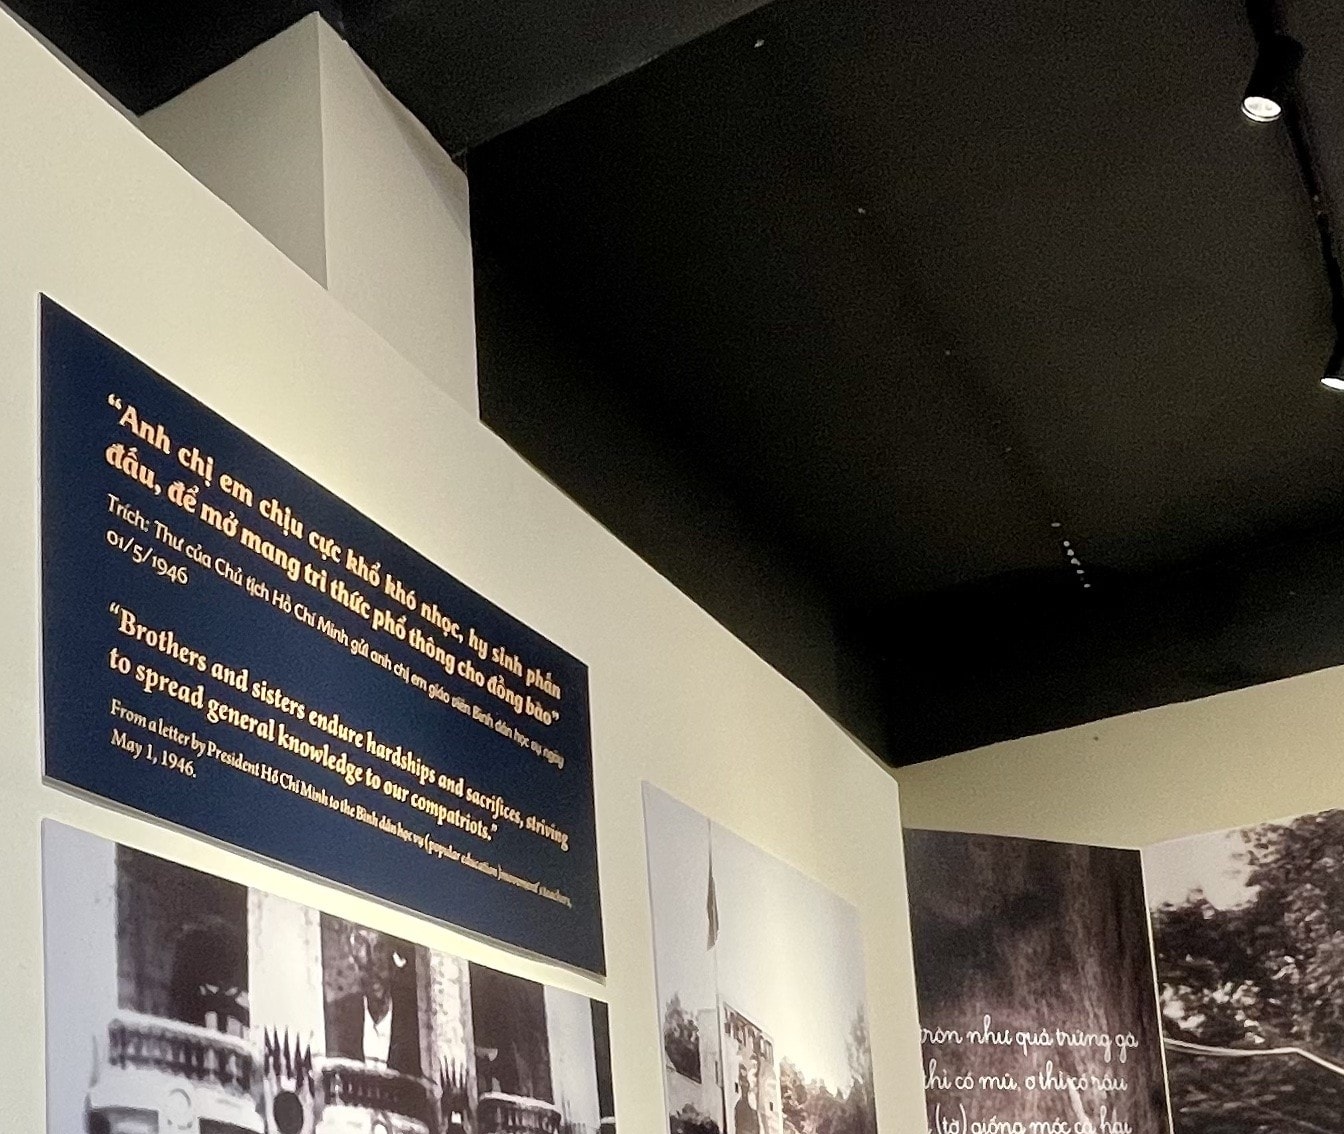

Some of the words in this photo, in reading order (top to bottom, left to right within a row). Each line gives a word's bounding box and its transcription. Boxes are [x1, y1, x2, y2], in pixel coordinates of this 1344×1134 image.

[106, 530, 189, 585] 01/5/1946
[154, 520, 185, 551] Thư
[186, 544, 212, 568] của
[215, 558, 244, 587] Chủ
[245, 575, 270, 601] tịch
[272, 589, 292, 613] Hồ
[294, 603, 316, 627] Chí
[317, 616, 348, 646] Minh
[370, 650, 392, 671] anh
[411, 673, 427, 692] em
[167, 480, 199, 513] để
[200, 503, 239, 537] mở
[240, 527, 301, 581] mang
[330, 580, 371, 619] thức
[372, 608, 407, 640] phổ
[409, 629, 455, 675] thông
[457, 660, 485, 687] cho
[487, 675, 523, 714] đồng
[178, 447, 214, 487] chị
[219, 474, 253, 507] em
[259, 498, 303, 539] chịu
[308, 531, 342, 563] cực
[346, 549, 381, 587] khổ
[384, 573, 417, 610] khó
[420, 602, 464, 643] nhọc,
[468, 628, 488, 660] hy
[492, 646, 522, 677] sinh
[109, 647, 131, 674] to
[135, 664, 205, 709] spread
[206, 698, 275, 742] general
[278, 723, 363, 786] knowledge
[365, 767, 381, 790] to
[383, 780, 410, 802] our
[110, 728, 143, 759] May
[110, 698, 147, 728] From
[148, 720, 157, 733] a
[158, 717, 190, 747] letter
[191, 732, 206, 758] by
[206, 740, 260, 778] President
[300, 780, 328, 806] Minh
[329, 795, 339, 810] to
[340, 798, 355, 818] the
[211, 662, 249, 692] and
[251, 680, 306, 720] sisters
[308, 710, 364, 748] endure
[366, 731, 436, 785] hardships
[438, 774, 464, 797] and
[466, 787, 524, 829] sacrifices,
[526, 815, 569, 852] striving
[955, 1072, 974, 1090] có
[1039, 1060, 1067, 1090] thì
[967, 1014, 1012, 1045] như
[1016, 1027, 1053, 1056] quả
[1056, 1028, 1112, 1062] trứng
[1115, 1031, 1139, 1063] gà
[1029, 1116, 1071, 1134] móc
[1100, 1105, 1133, 1134] hai
